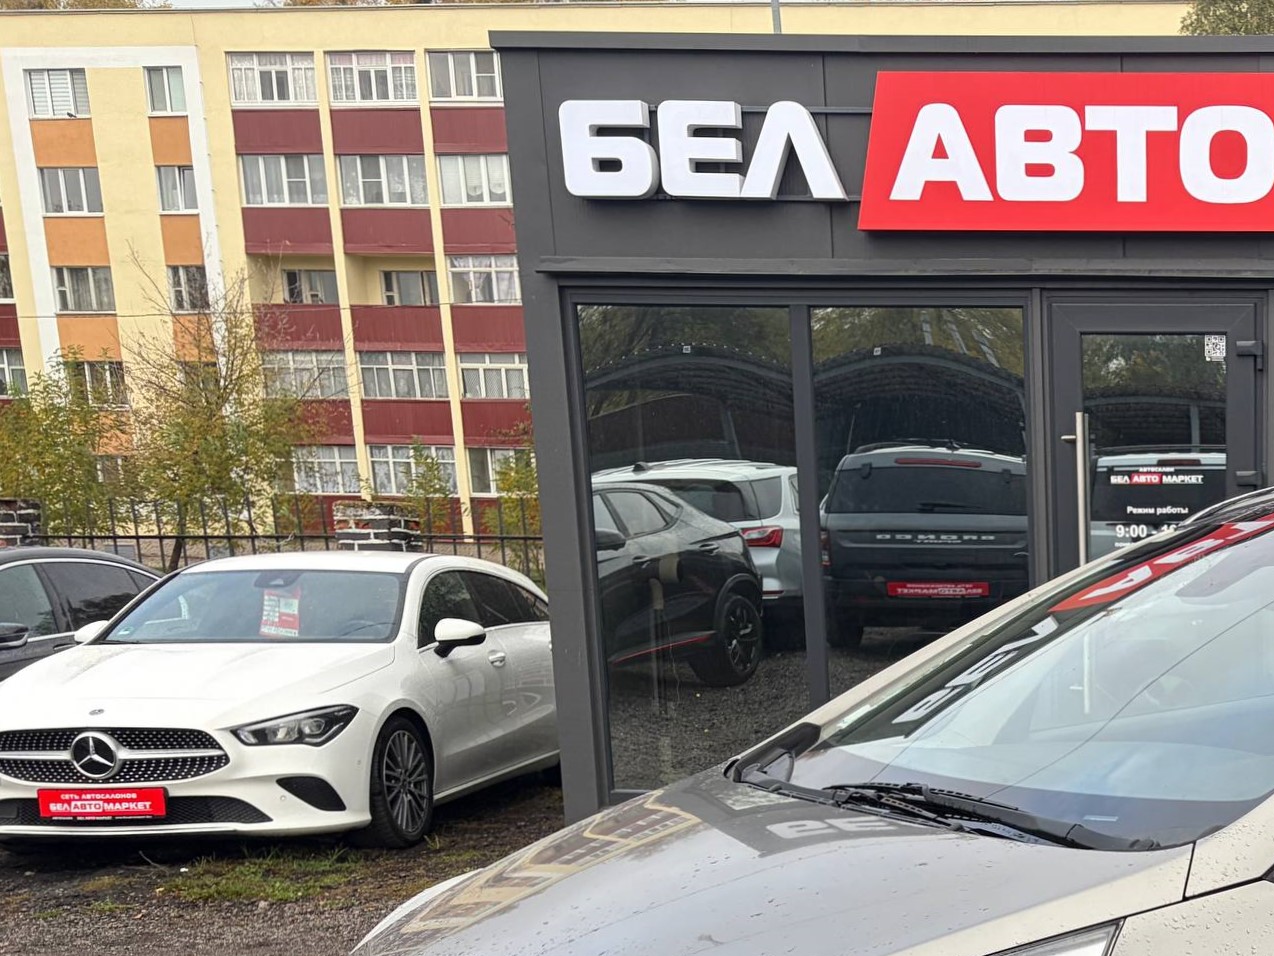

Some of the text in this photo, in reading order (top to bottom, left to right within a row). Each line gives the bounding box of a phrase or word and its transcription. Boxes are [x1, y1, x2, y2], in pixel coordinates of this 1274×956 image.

[558, 99, 848, 200] БЕЛ
[1110, 475, 1204, 484] БЕЛ АВТО МАРКЕТ
[1126, 505, 1189, 516] Режим работы
[1115, 524, 1148, 538] 9:00
[49, 801, 152, 812] БЕЛ АВТО МАРКЕТ
